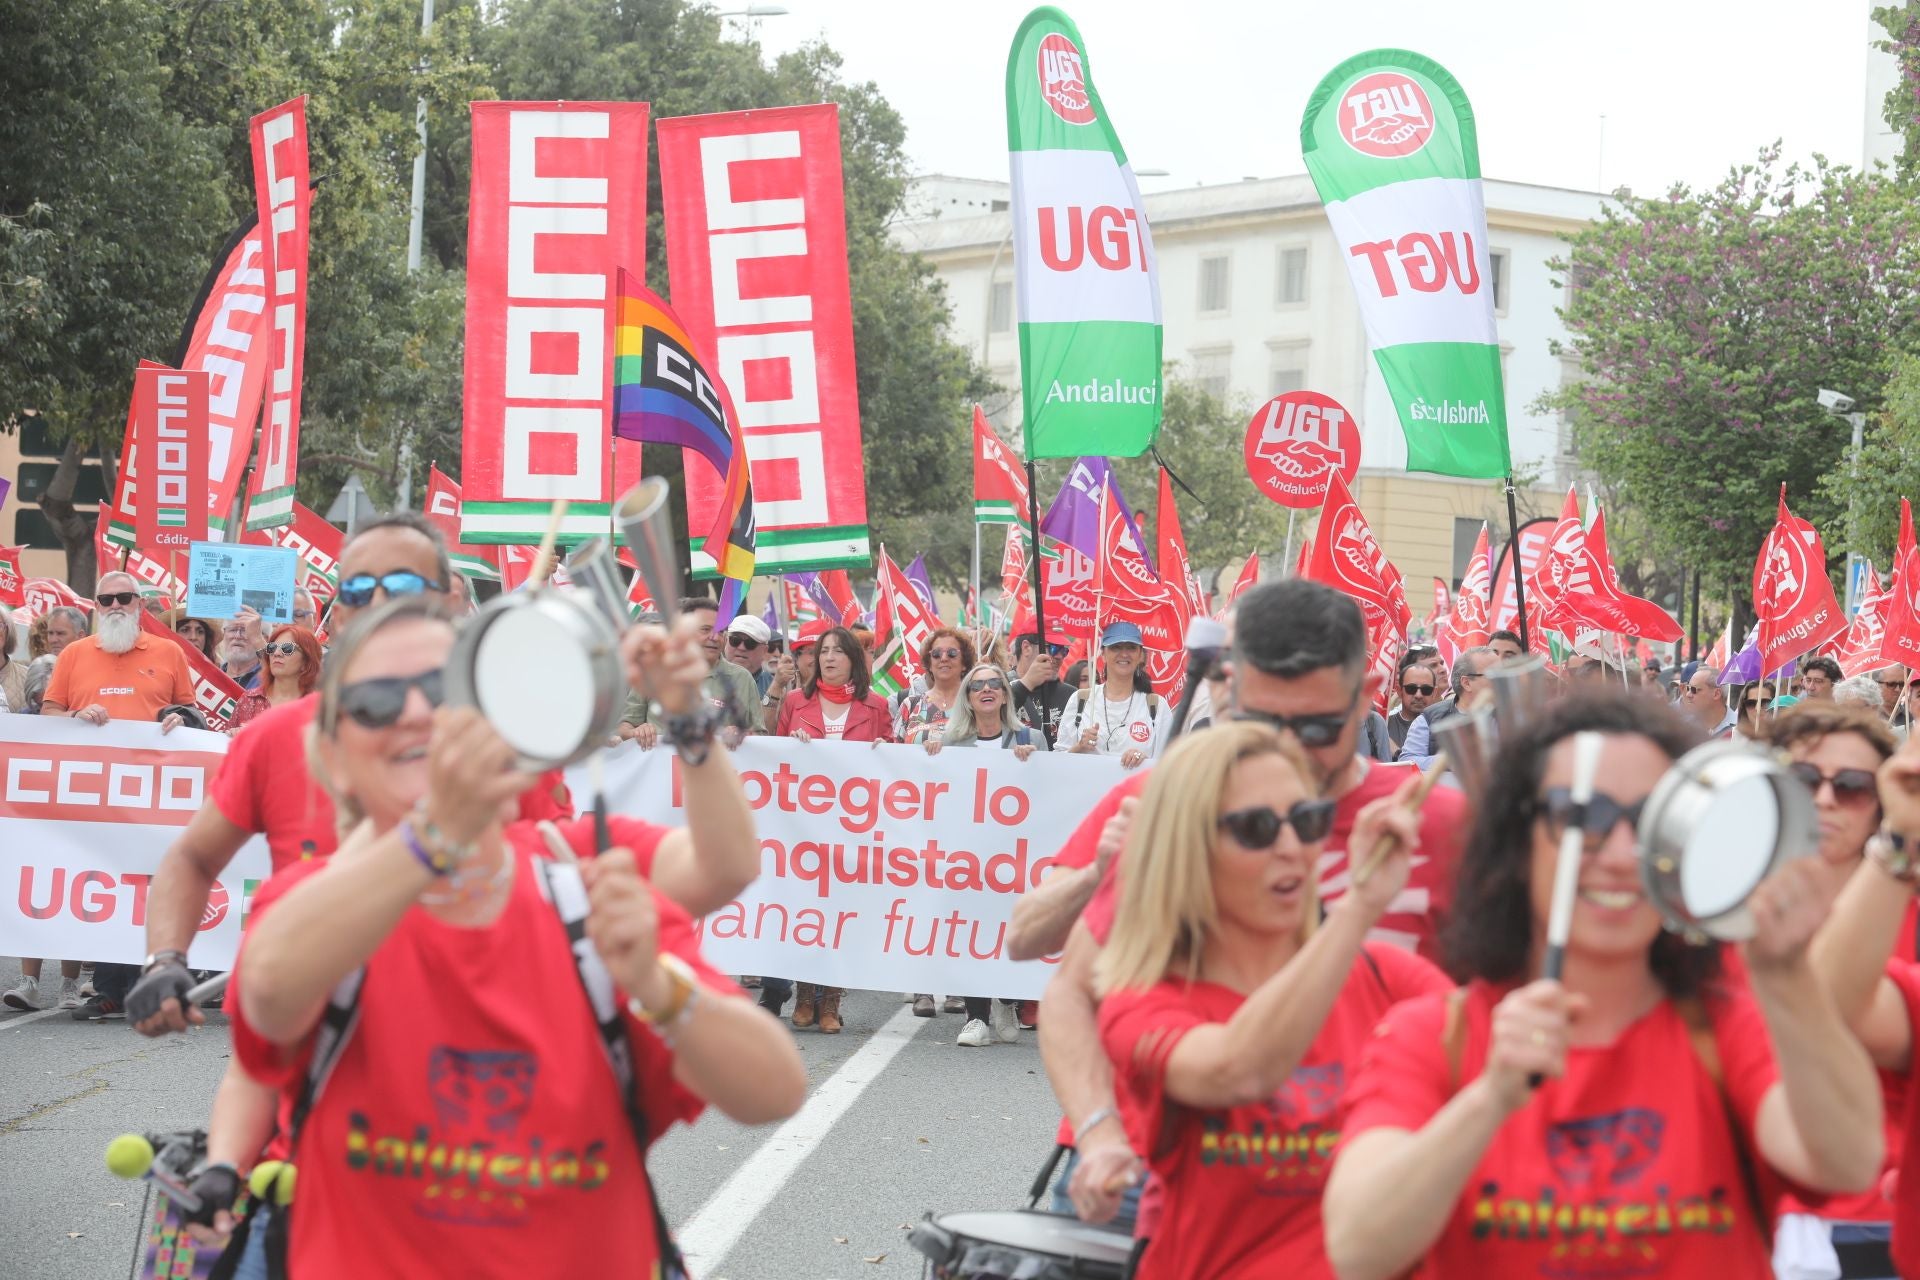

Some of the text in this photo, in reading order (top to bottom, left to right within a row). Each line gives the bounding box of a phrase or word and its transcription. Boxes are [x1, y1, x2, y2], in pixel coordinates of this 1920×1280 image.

[1042, 48, 1084, 84] UGT
[1037, 205, 1149, 273] UGT
[262, 112, 297, 491] CCOO
[503, 111, 609, 500] CCOO
[700, 130, 829, 527] CCOO
[157, 375, 188, 504] CCOO
[1261, 400, 1345, 451] UGT
[1266, 474, 1328, 495] Andalucía
[155, 533, 189, 545] Cádiz
[1048, 548, 1096, 587] UG
[24, 588, 57, 616] GT
[6, 757, 205, 811] CCOO
[672, 755, 1031, 834] oteger lo
[17, 865, 156, 927] UGT
